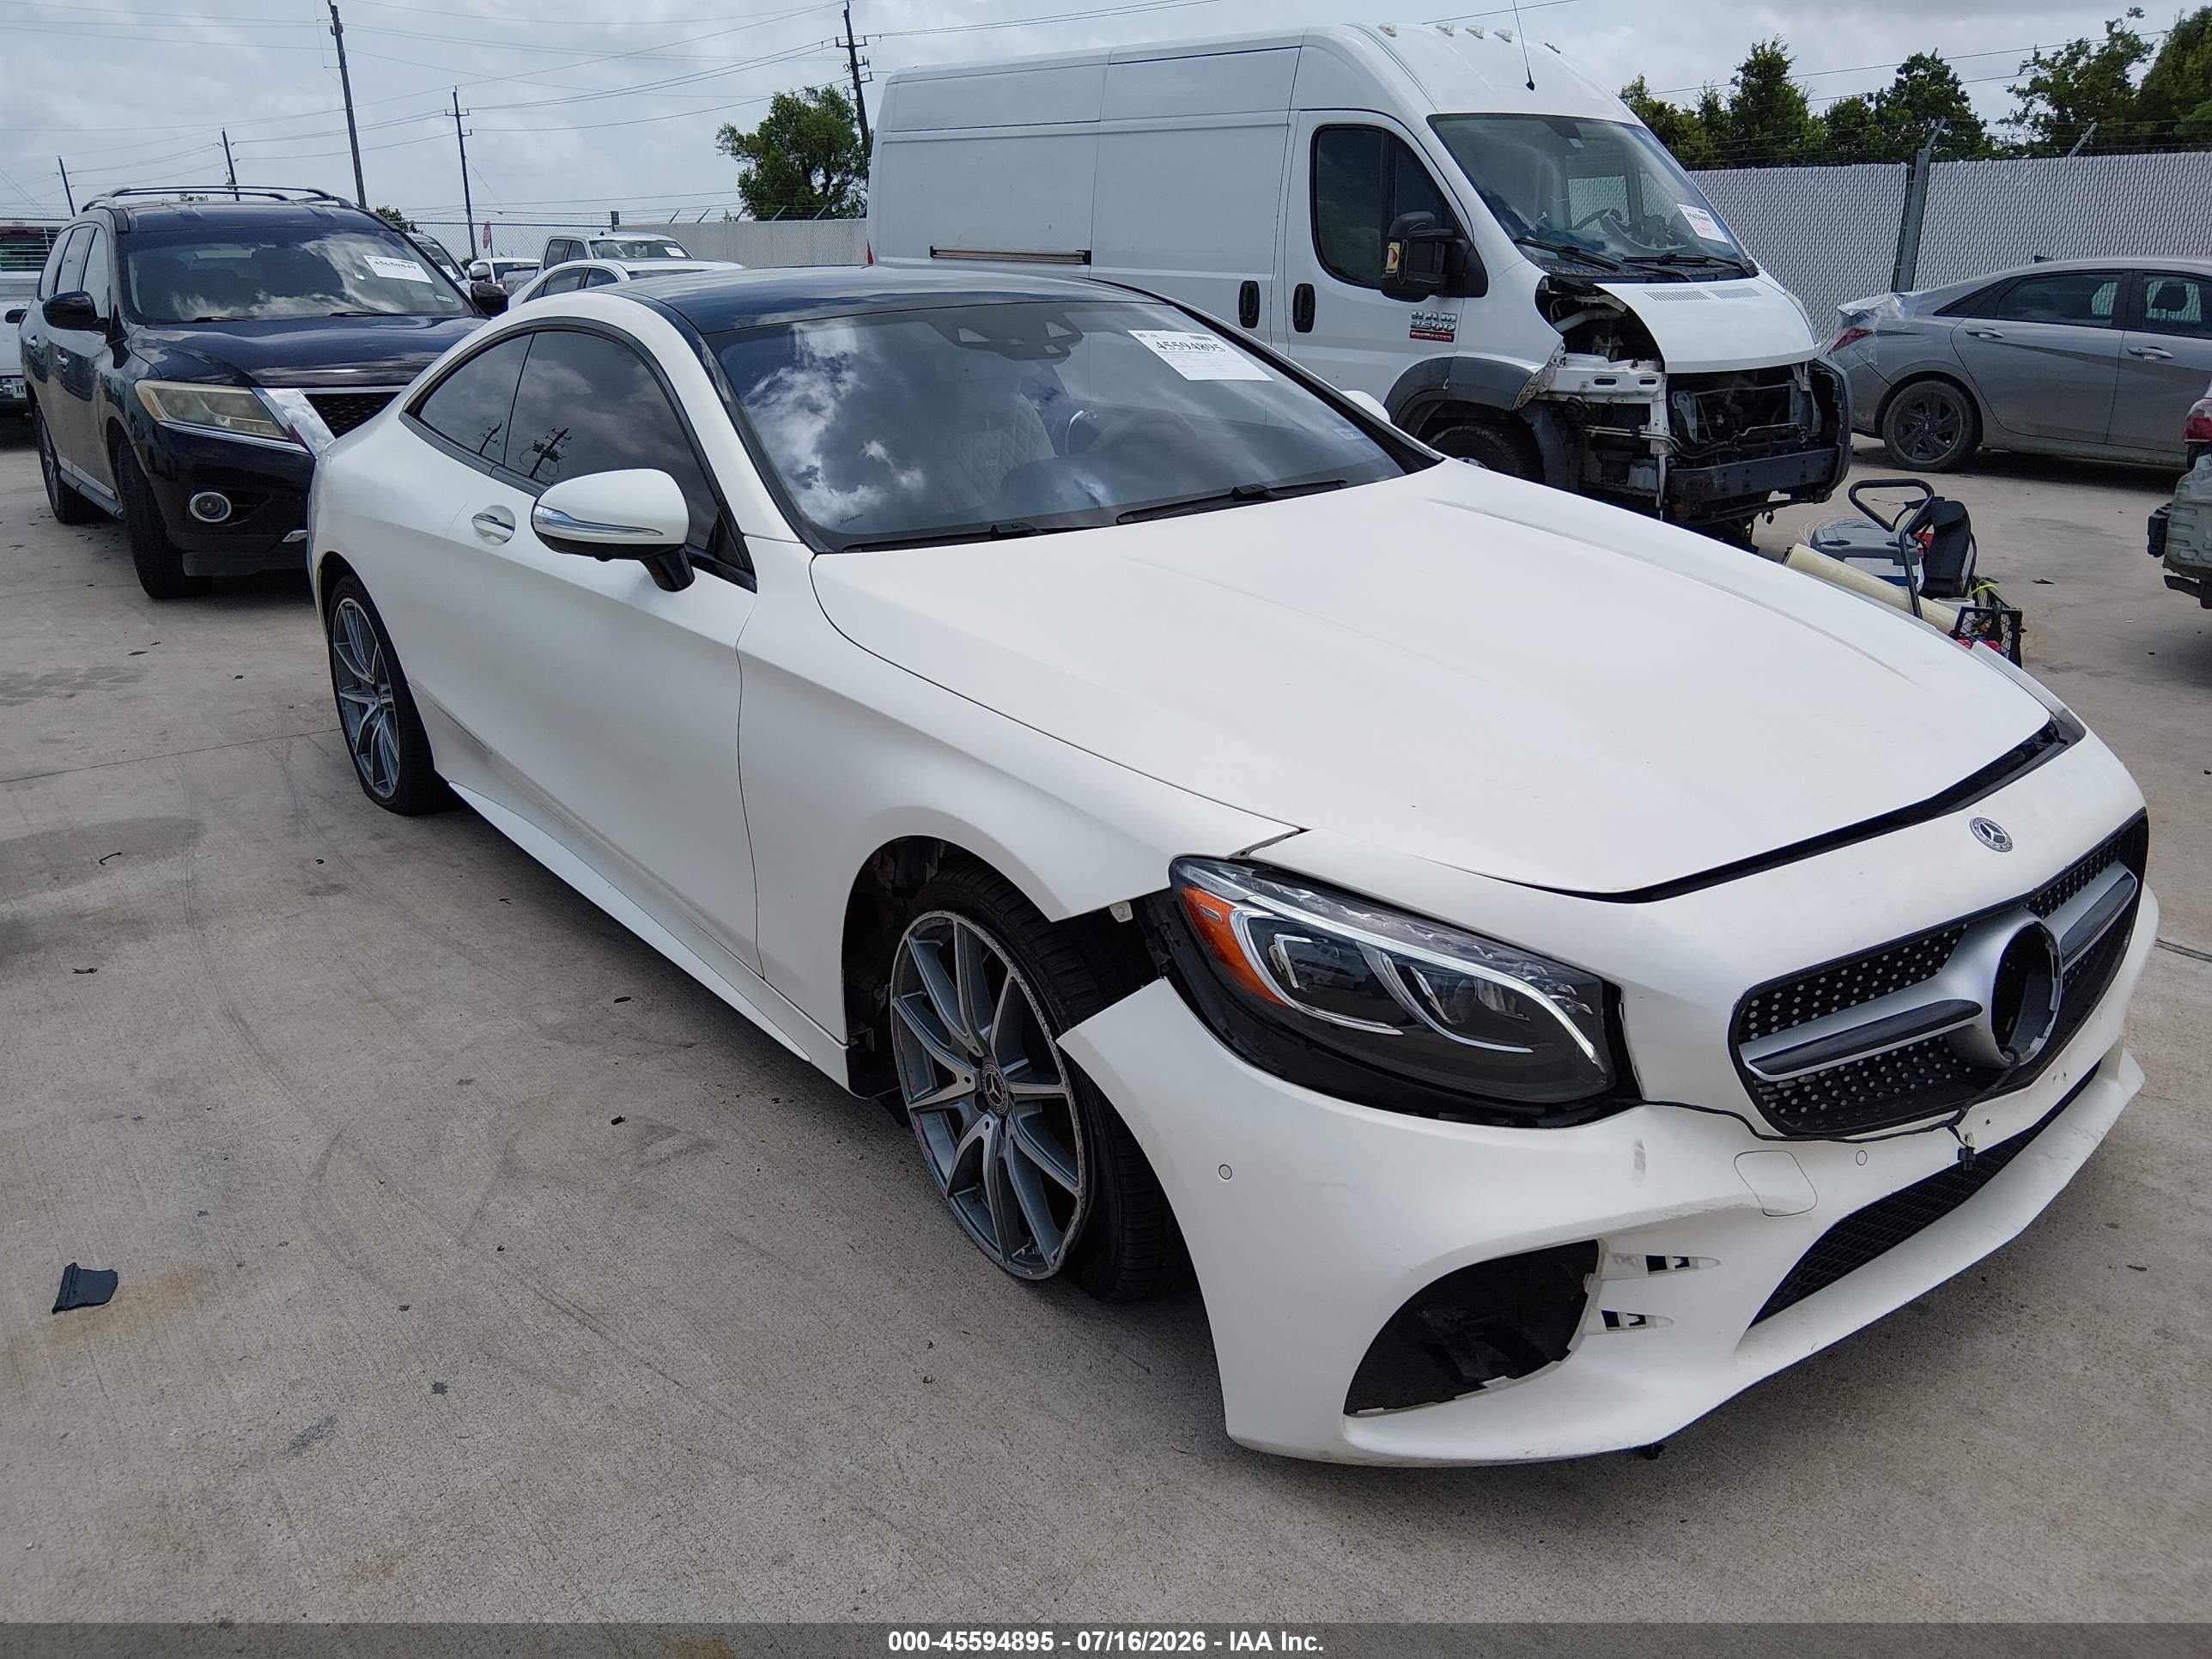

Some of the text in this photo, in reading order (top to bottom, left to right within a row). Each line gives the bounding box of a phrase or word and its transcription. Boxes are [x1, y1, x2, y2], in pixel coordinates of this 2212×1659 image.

[1411, 310, 1457, 323] RAM
[1410, 320, 1456, 332] 2500
[1156, 341, 1226, 353] 45594895
